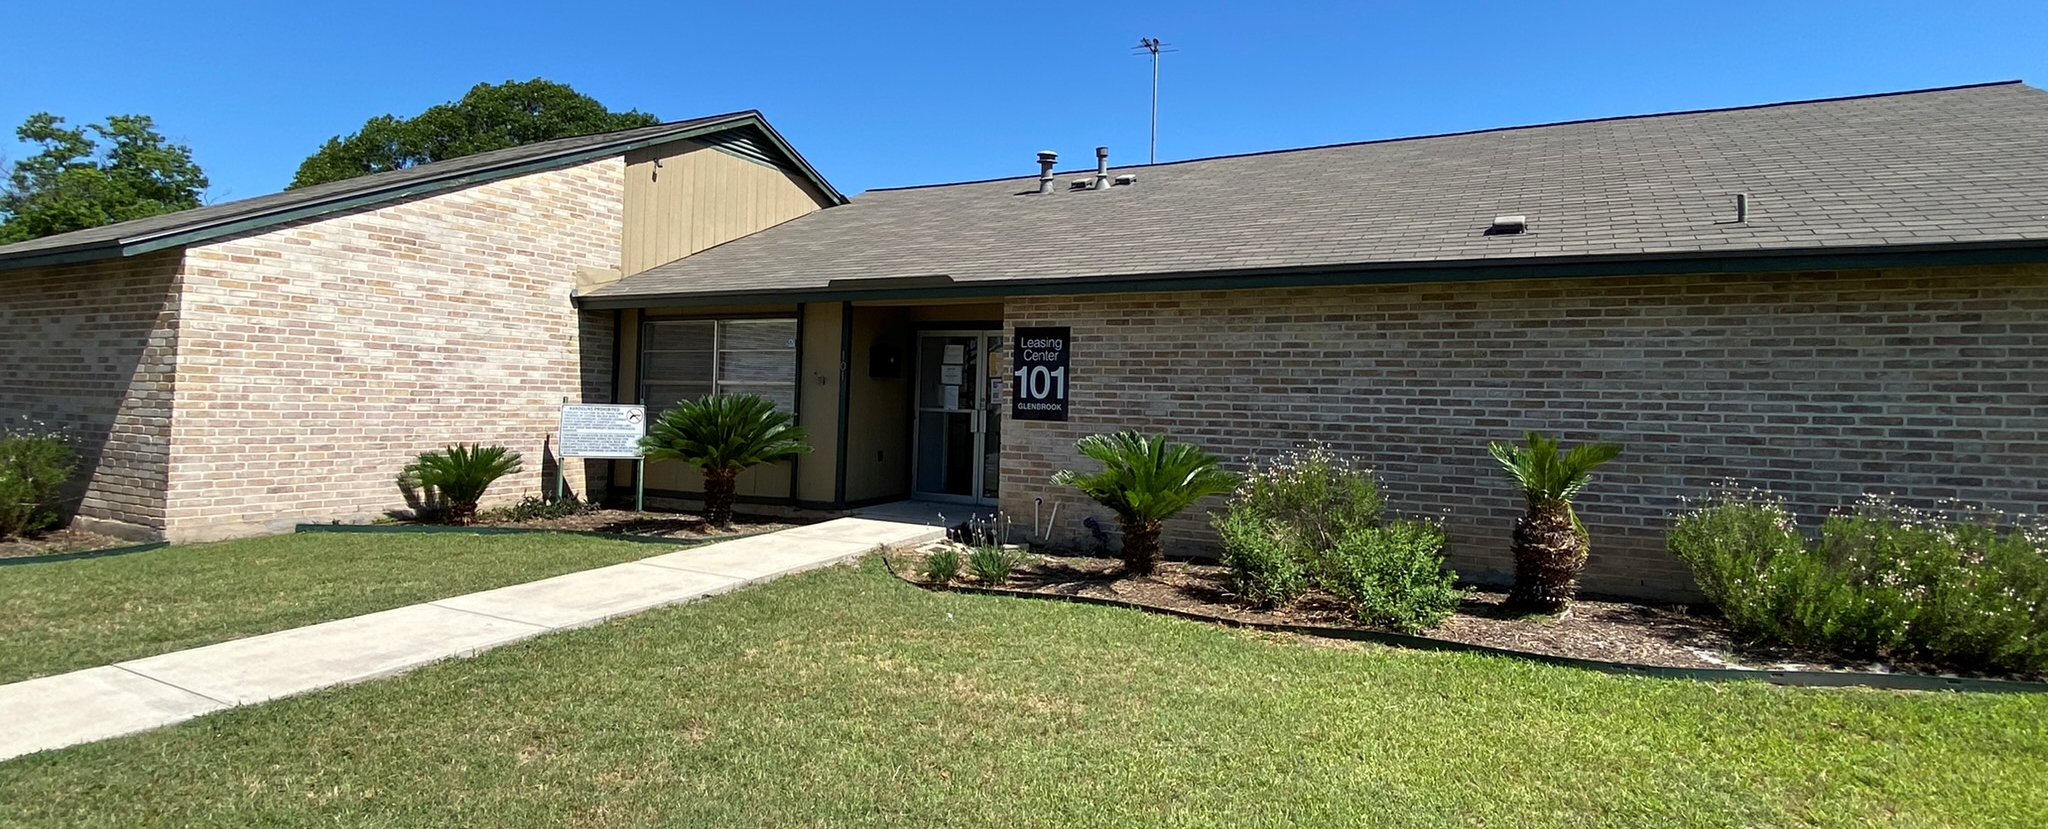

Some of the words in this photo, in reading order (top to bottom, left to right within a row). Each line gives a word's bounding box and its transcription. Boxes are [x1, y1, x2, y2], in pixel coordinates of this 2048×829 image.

[1021, 337, 1062, 350] Leasing
[1023, 349, 1059, 361] Center
[1014, 365, 1064, 399] 101
[1017, 402, 1062, 411] GLENBROOK
